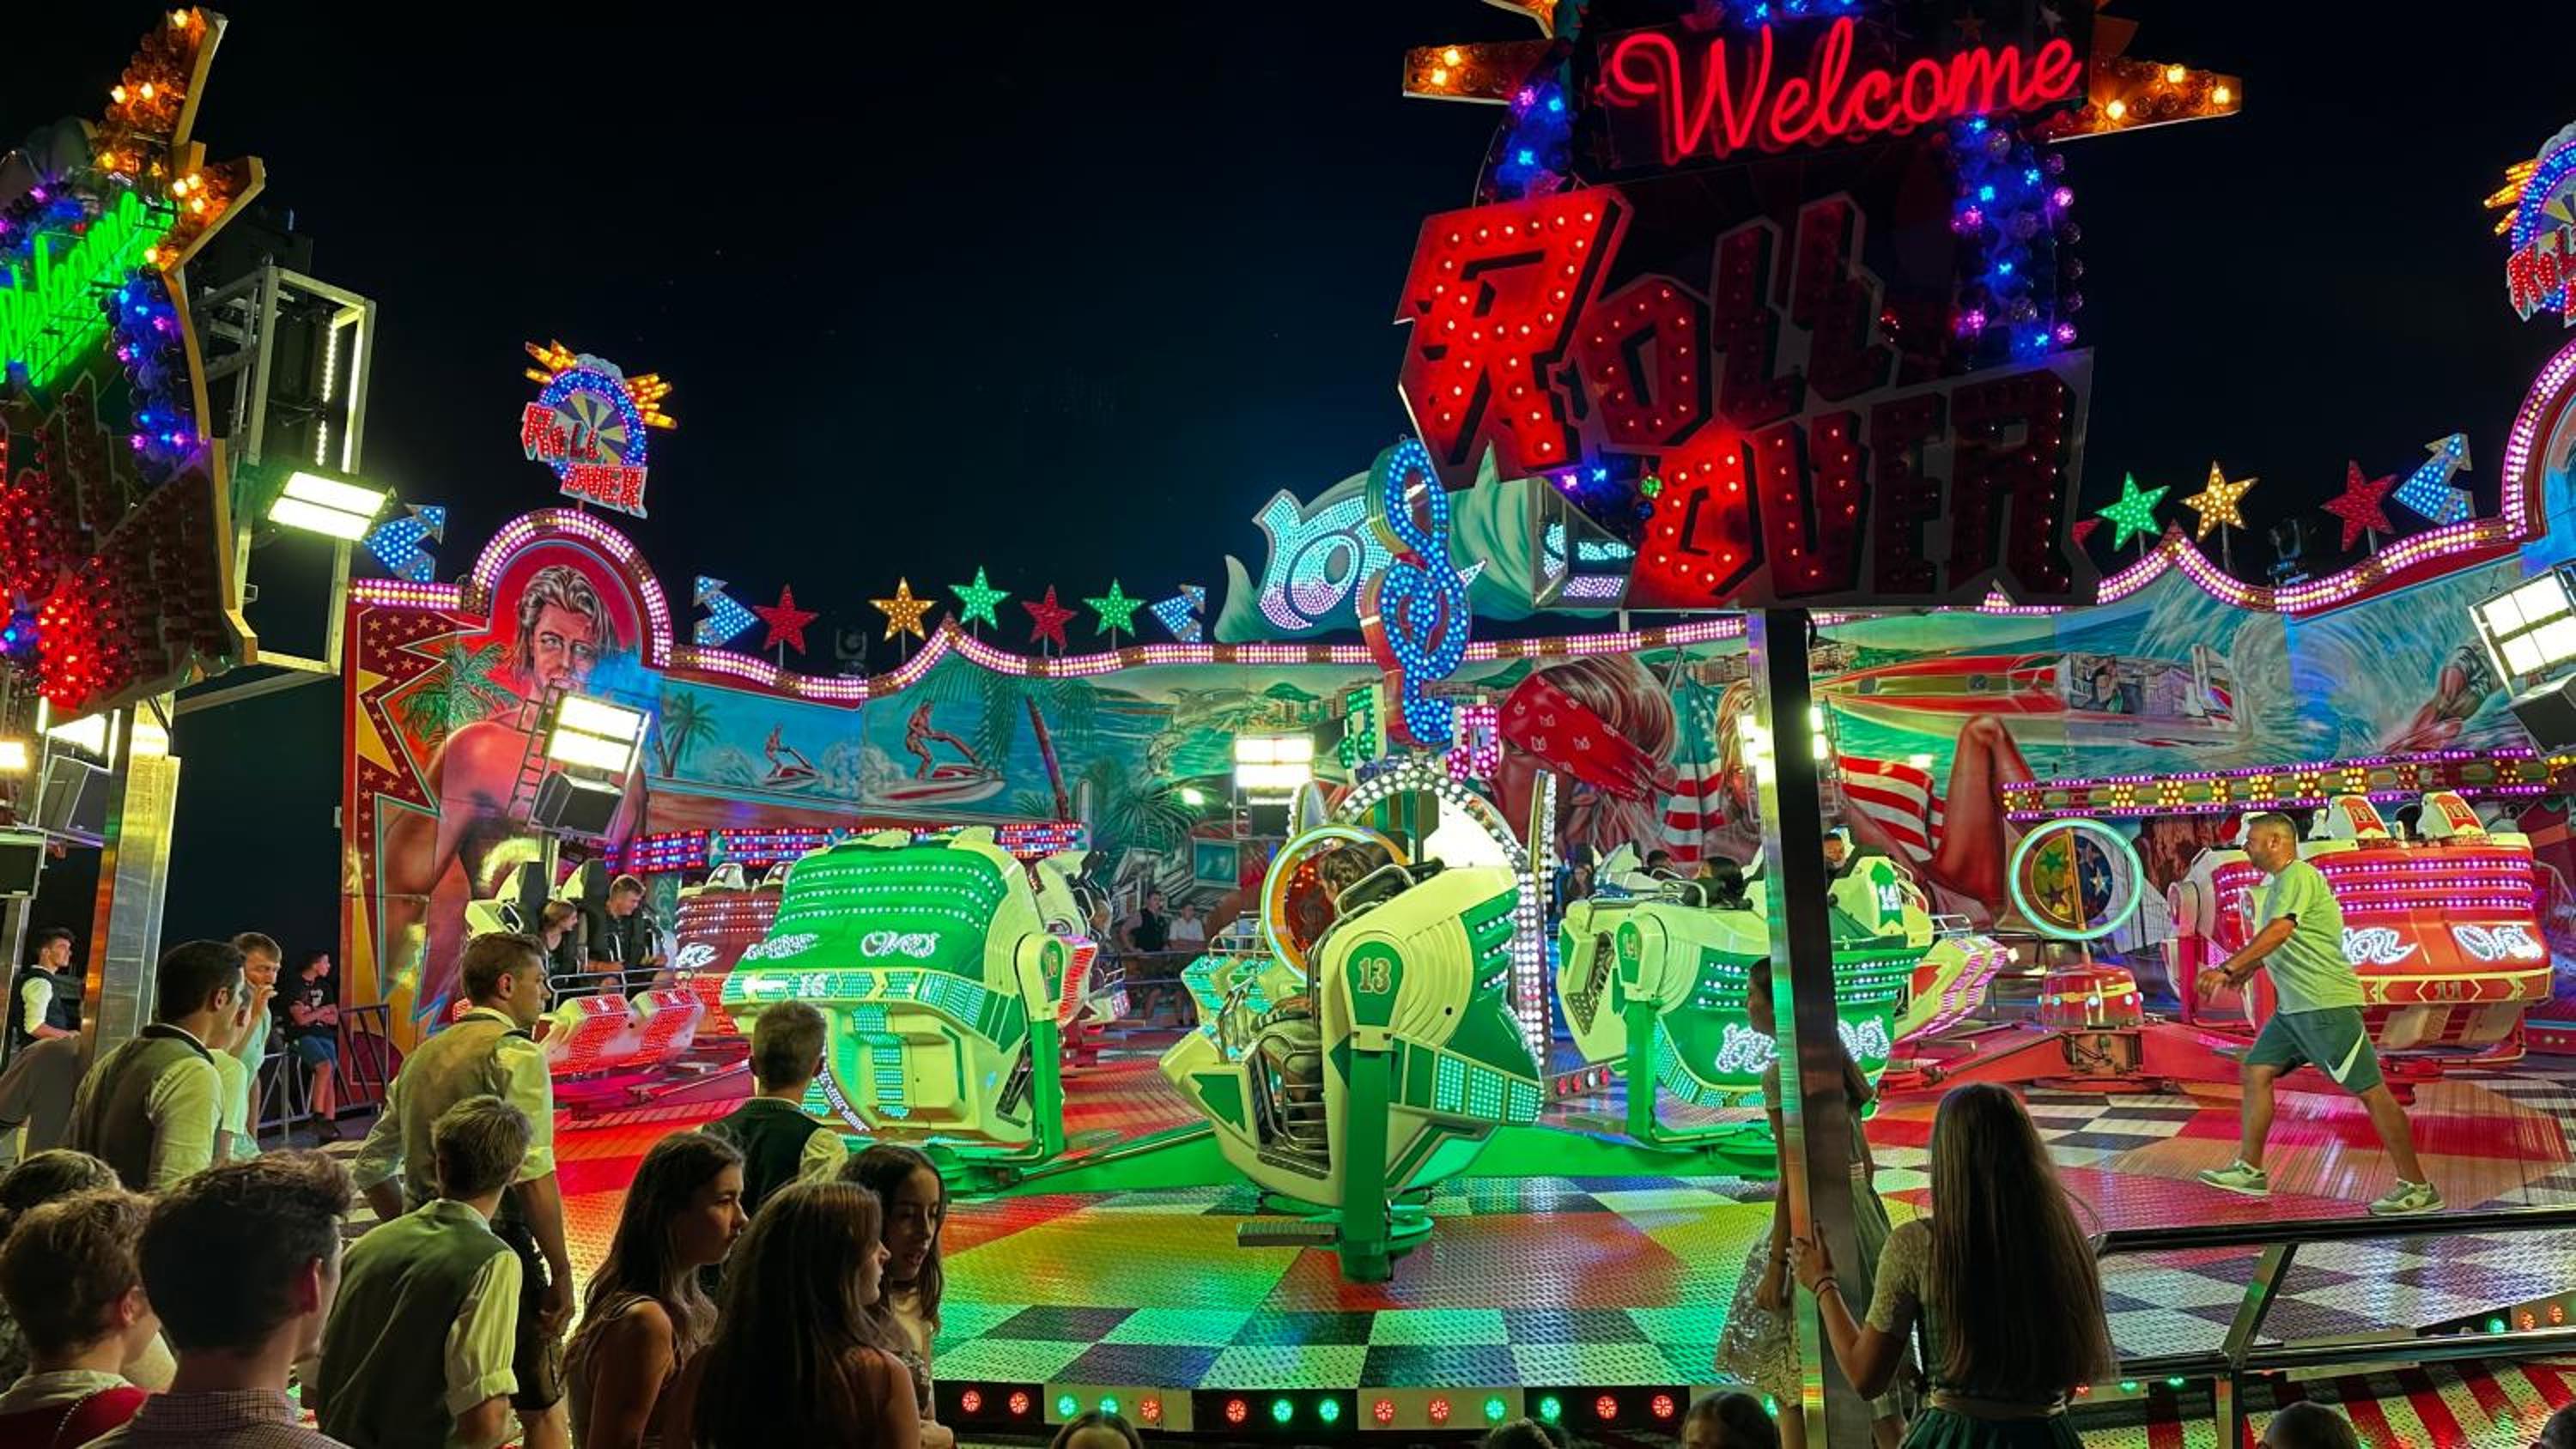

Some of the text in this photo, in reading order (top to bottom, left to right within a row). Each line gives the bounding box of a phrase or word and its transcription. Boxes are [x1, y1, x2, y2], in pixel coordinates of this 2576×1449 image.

[1611, 15, 2083, 156] Welcome
[1633, 367, 2078, 603] OVER
[1358, 957, 1392, 995] 13
